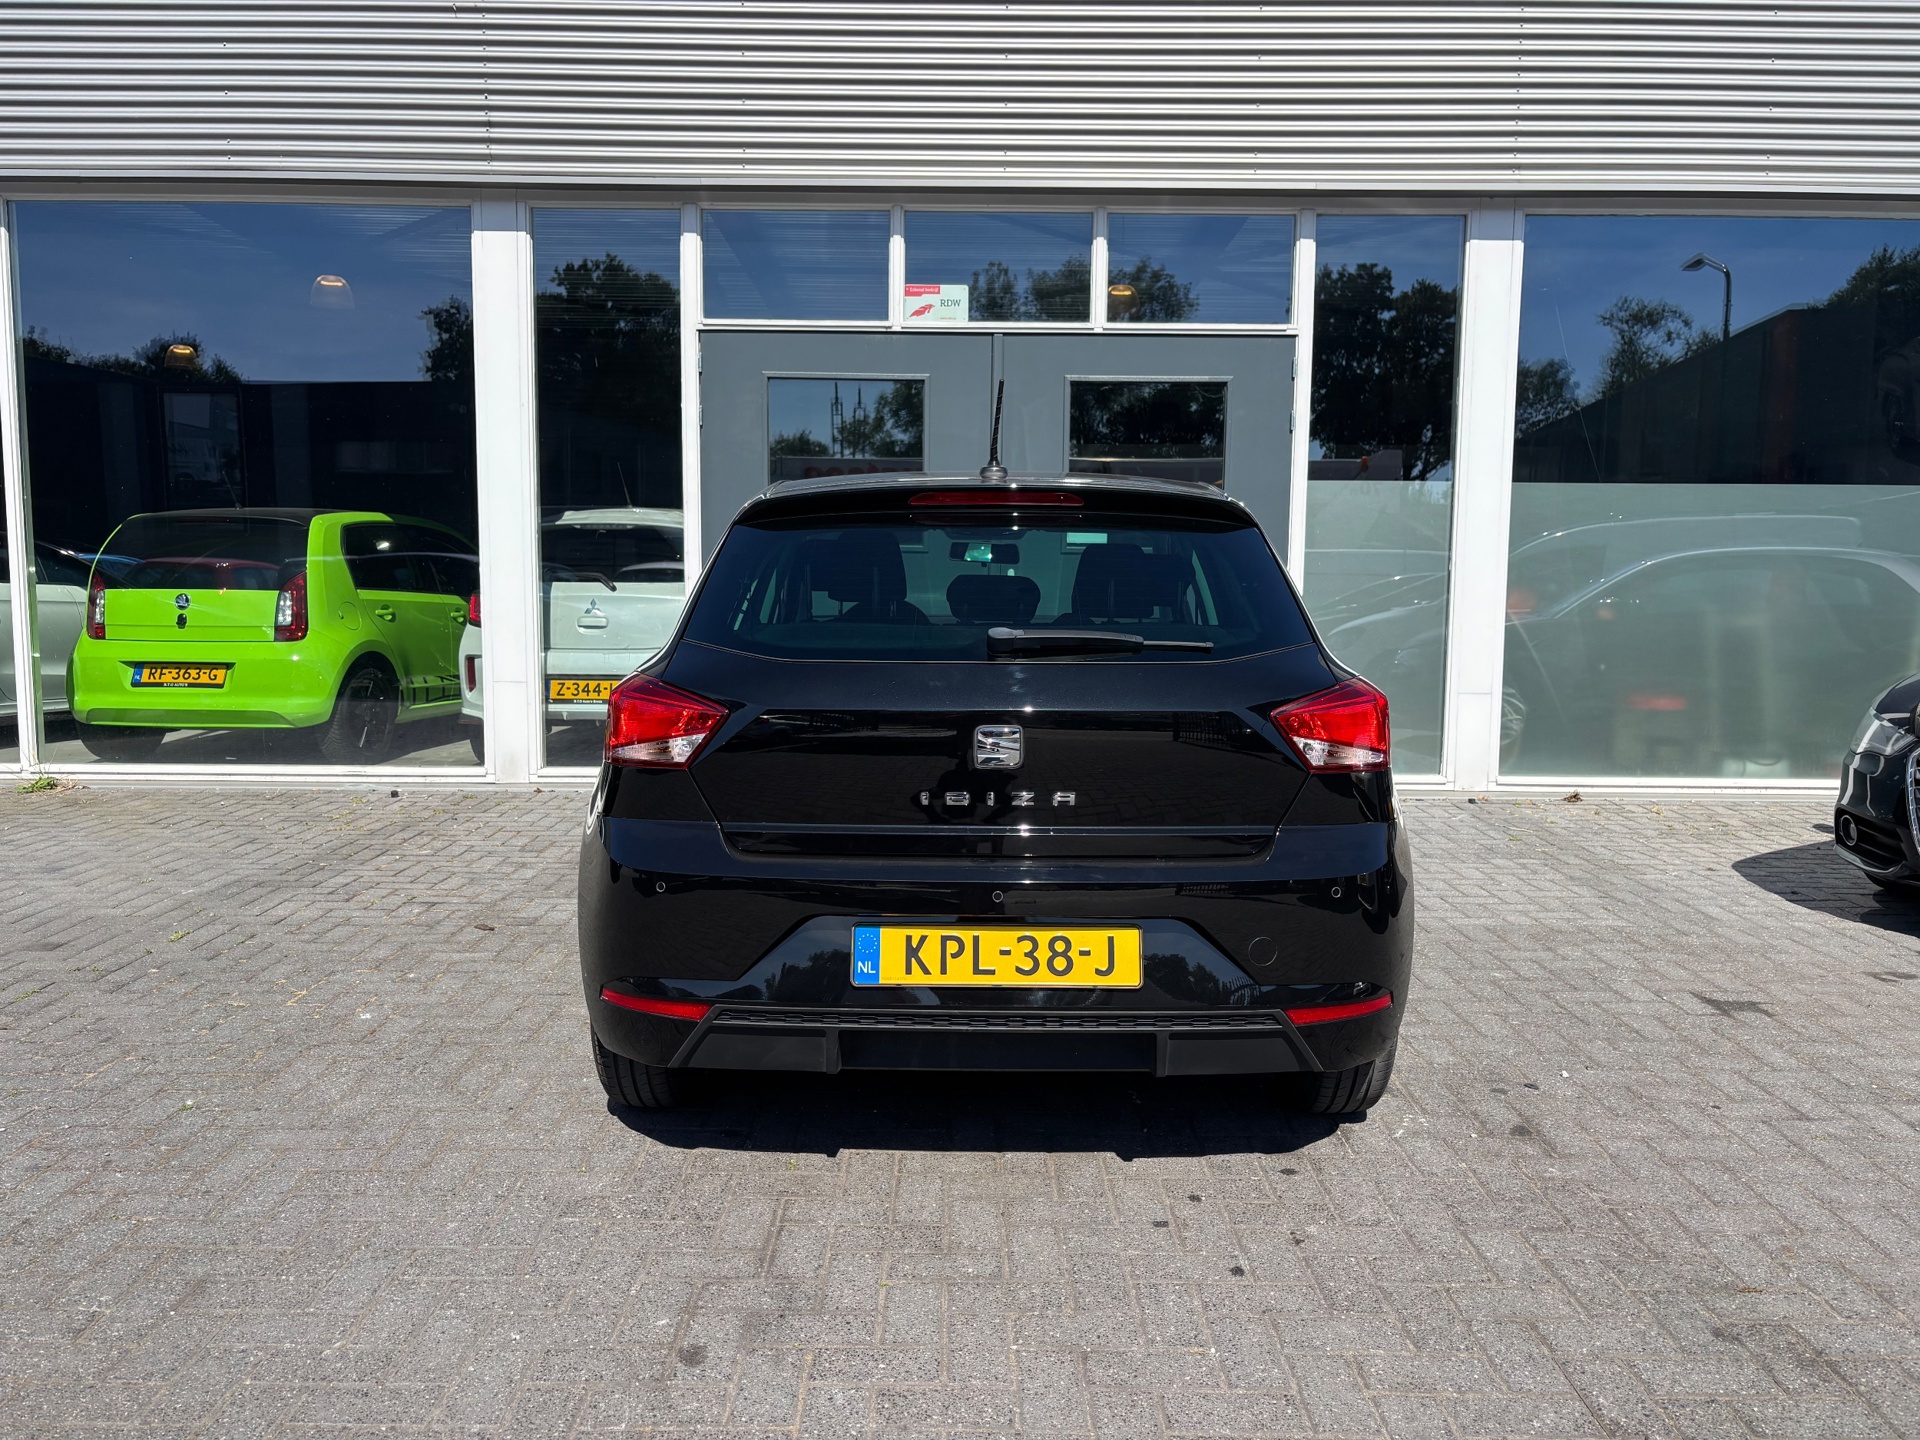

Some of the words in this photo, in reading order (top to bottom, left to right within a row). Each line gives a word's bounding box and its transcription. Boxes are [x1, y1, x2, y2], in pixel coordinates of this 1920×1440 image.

[940, 299, 961, 308] RDW
[147, 666, 219, 681] RF-363-G
[920, 791, 1076, 807] IBIZA
[904, 934, 1116, 977] KPL-38-J
[857, 960, 877, 974] NL
